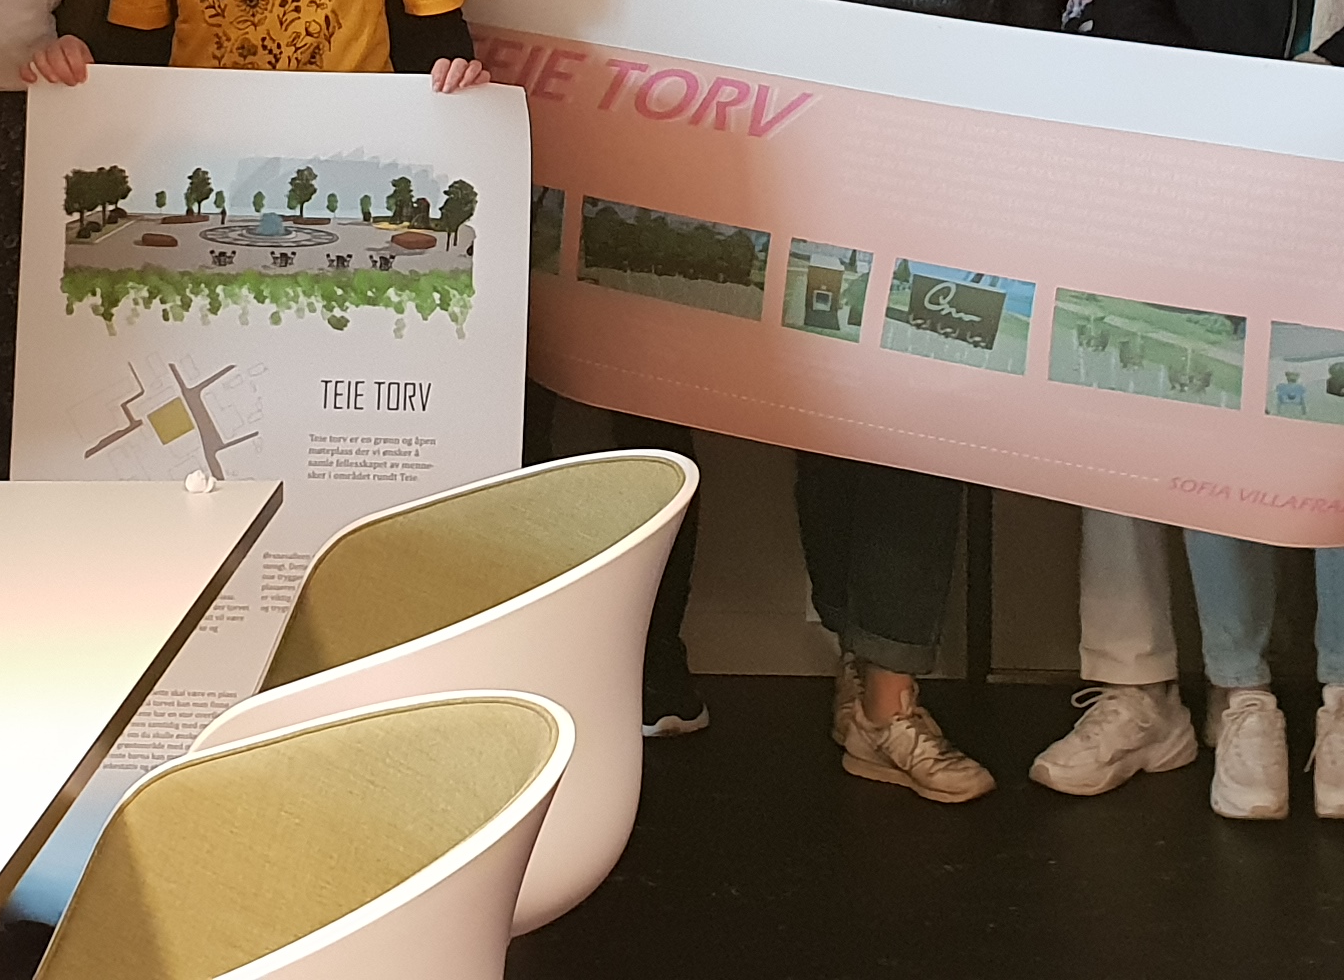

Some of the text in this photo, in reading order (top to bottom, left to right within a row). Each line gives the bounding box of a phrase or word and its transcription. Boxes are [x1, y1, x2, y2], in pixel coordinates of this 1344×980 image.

[474, 36, 814, 138] EIE TORV
[320, 379, 432, 412] TEIE TORV
[309, 434, 327, 443] Teie
[329, 435, 348, 443] torv
[402, 438, 413, 446] og
[414, 436, 436, 447] åpen
[308, 447, 353, 457] møteplass
[355, 448, 369, 456] der
[372, 448, 380, 456] vi
[382, 449, 412, 457] ønsker
[308, 459, 334, 467] samle
[336, 459, 387, 470] fellesskapet
[308, 471, 326, 479] sker
[333, 471, 371, 480] området
[373, 472, 397, 481] rundt
[1168, 475, 1232, 500] SOFIA
